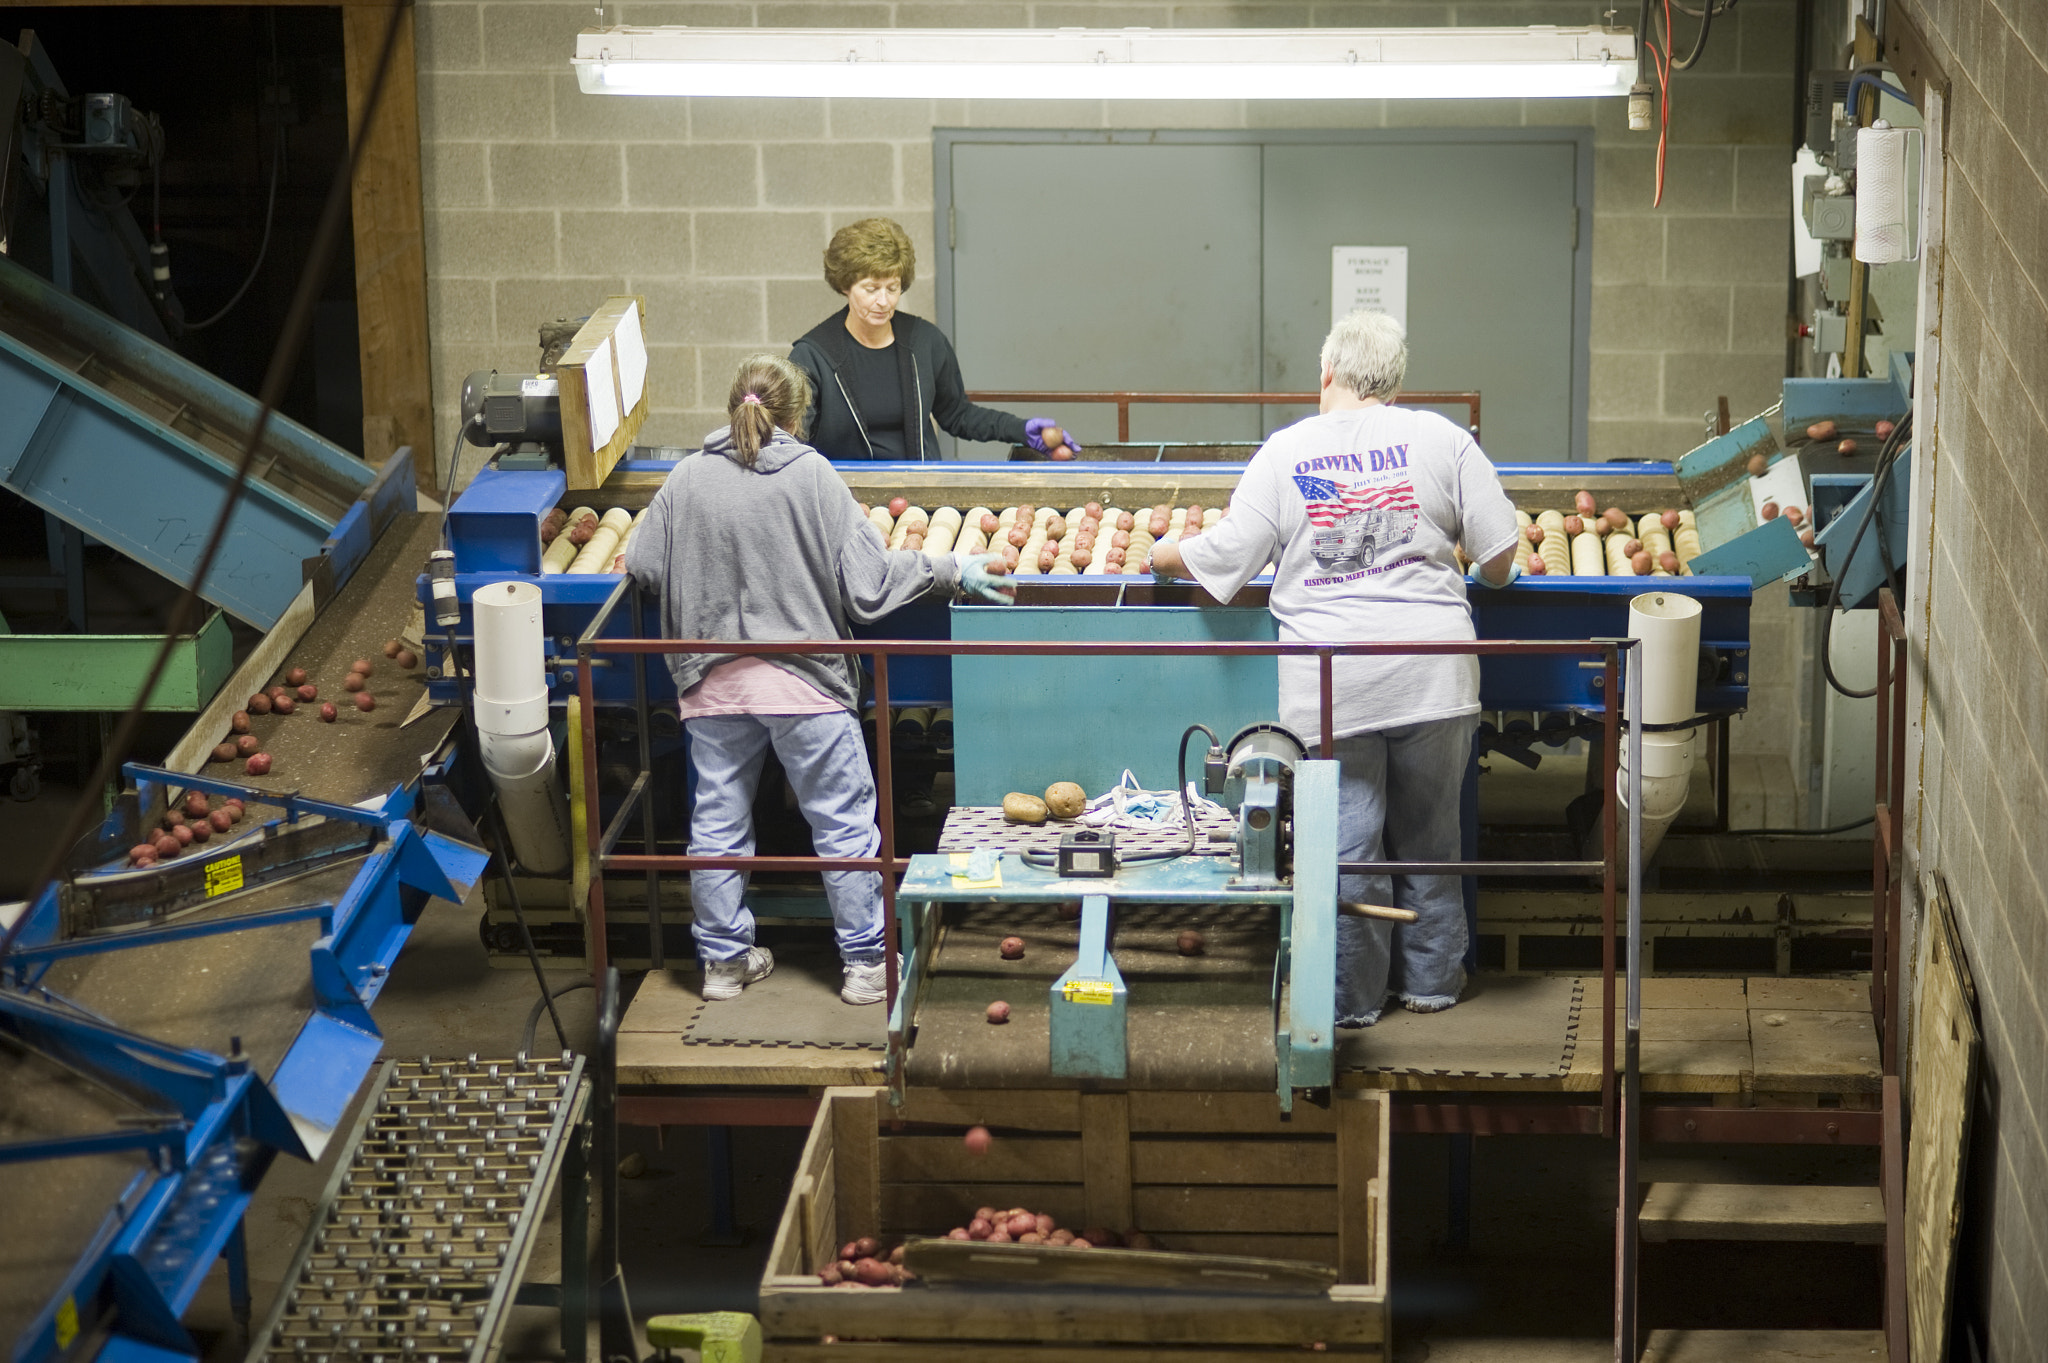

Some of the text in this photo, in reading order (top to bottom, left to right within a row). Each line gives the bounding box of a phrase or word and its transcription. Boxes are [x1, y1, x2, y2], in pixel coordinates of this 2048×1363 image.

[1294, 443, 1409, 474] ORWIN DAY
[1304, 555, 1427, 587] RISING TO MEET THE CHALLENGE
